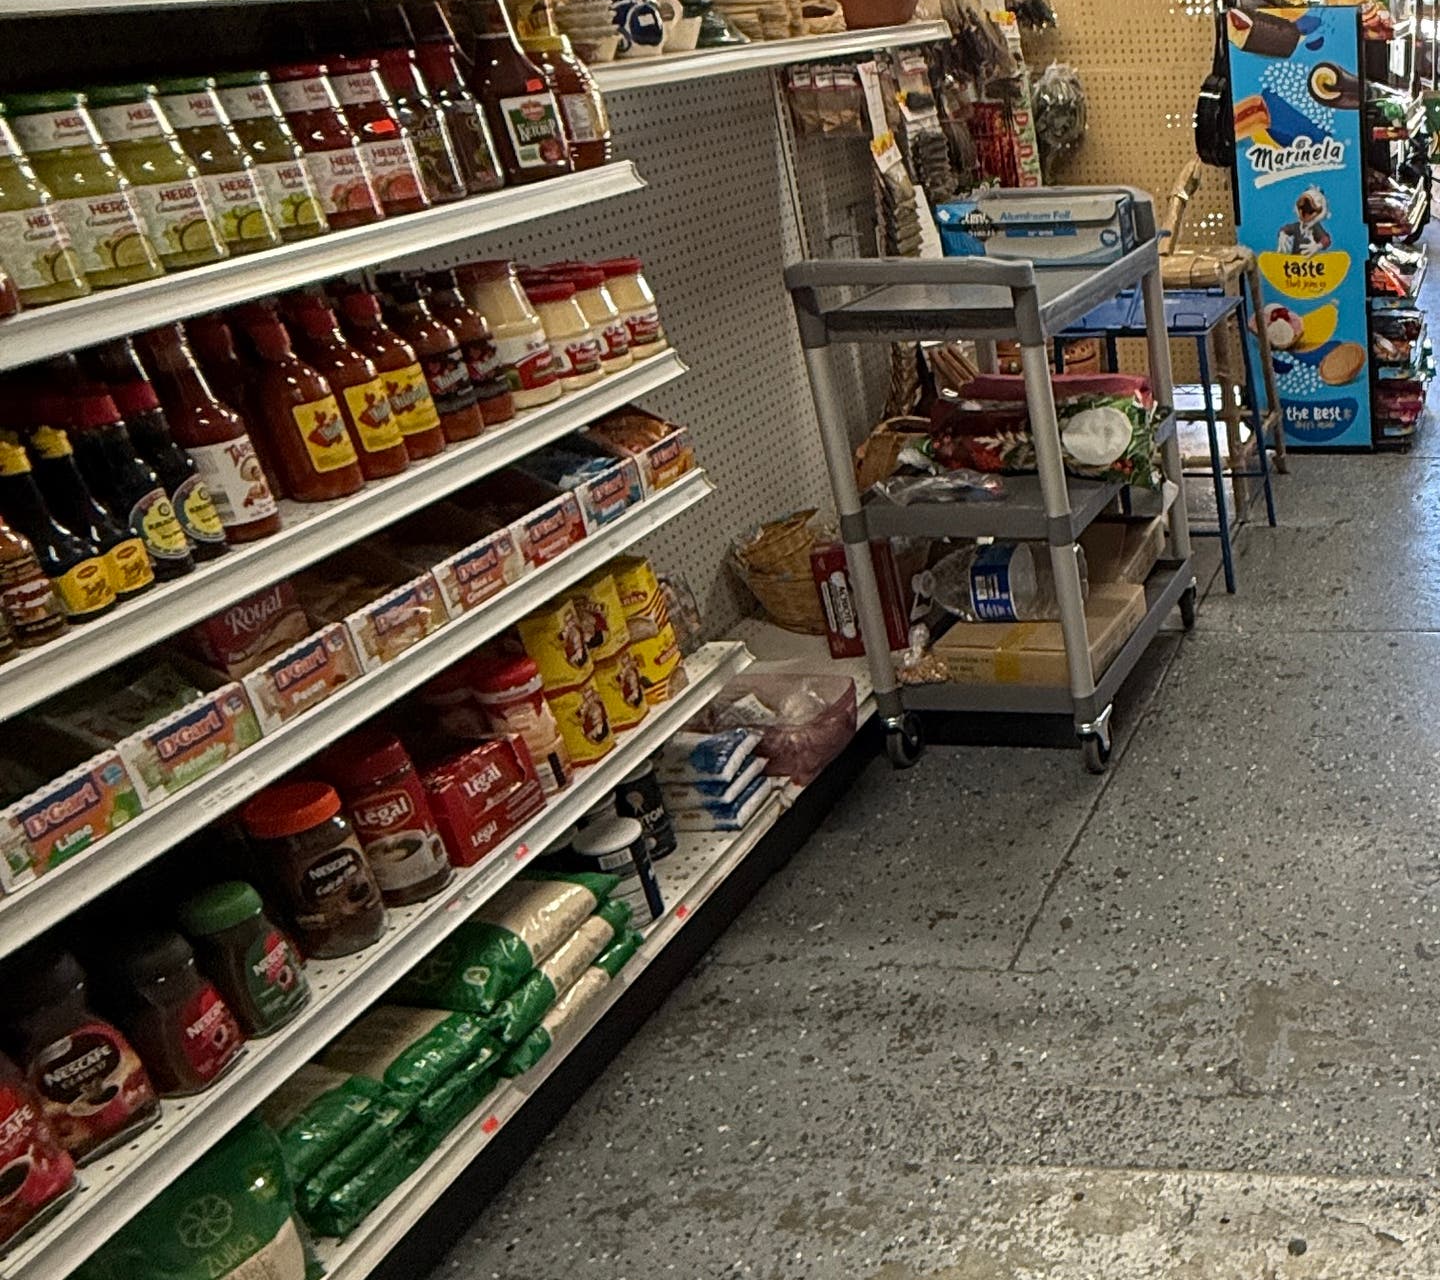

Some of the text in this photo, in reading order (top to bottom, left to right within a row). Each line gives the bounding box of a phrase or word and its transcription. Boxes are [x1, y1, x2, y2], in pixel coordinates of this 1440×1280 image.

[1249, 138, 1342, 173] Marinela
[88, 197, 130, 215] HERD
[159, 187, 199, 202] HERD
[1000, 209, 1072, 221] Aluminum Foil
[1283, 261, 1326, 279] taste
[1286, 405, 1343, 422] the Best
[223, 586, 282, 637] Royal
[463, 762, 502, 799] Legal
[353, 795, 409, 830] Legal
[55, 824, 93, 851] Lime
[471, 822, 498, 849] Legal
[199, 1234, 258, 1278] Zulka
